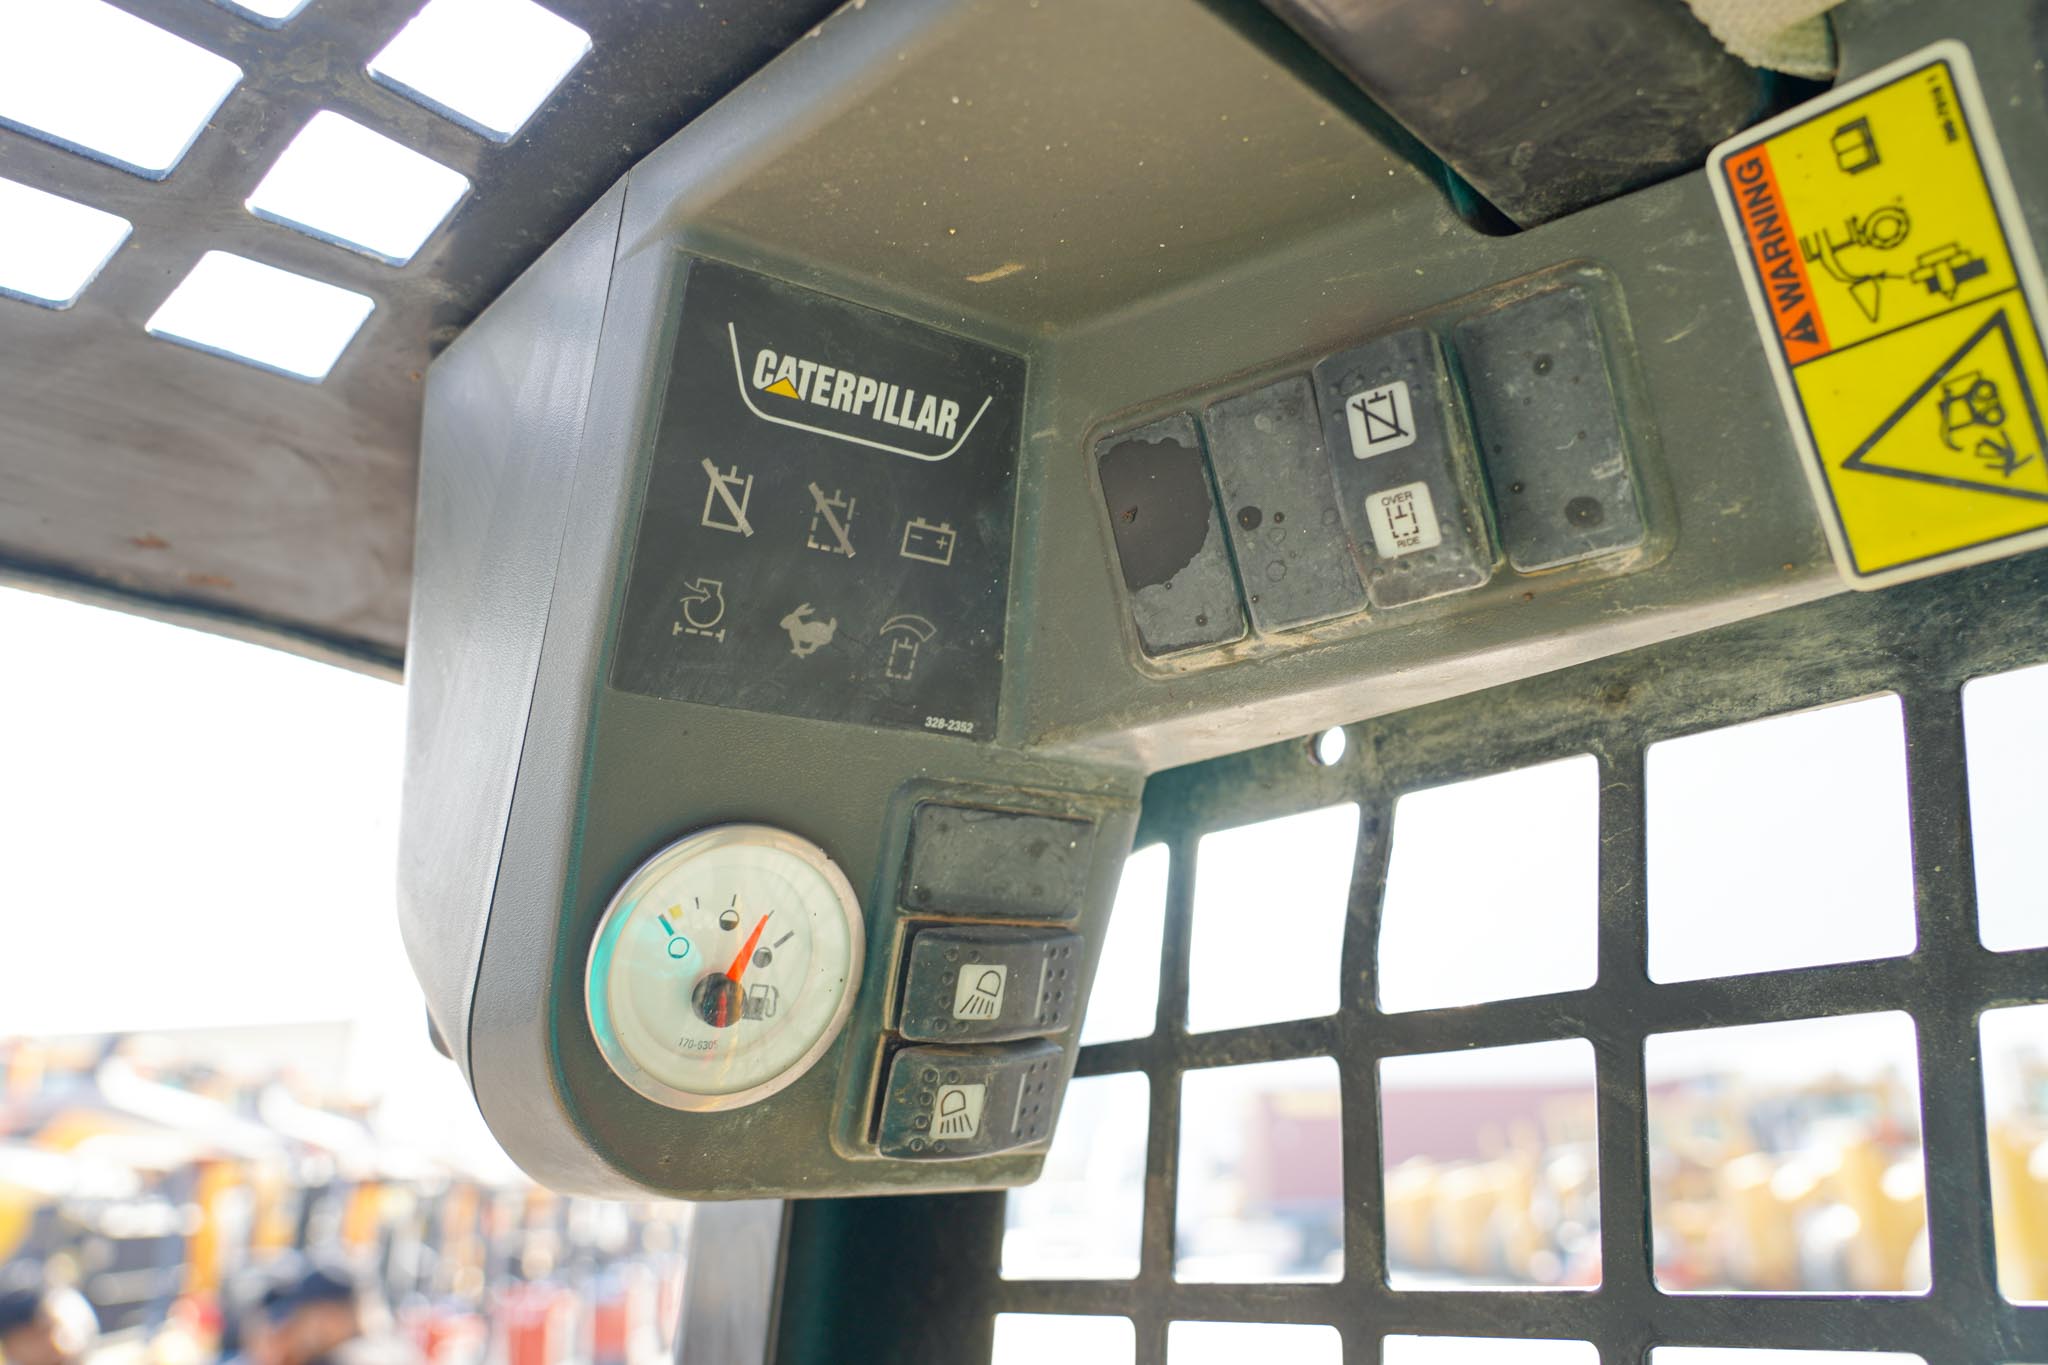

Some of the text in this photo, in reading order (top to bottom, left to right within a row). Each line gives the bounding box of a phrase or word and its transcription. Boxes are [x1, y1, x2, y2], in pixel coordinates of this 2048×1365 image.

[1736, 157, 1805, 313] WARNING
[752, 349, 961, 439] CATERPILLAR
[1381, 491, 1413, 506] OVER
[1396, 536, 1421, 548] RIDE
[924, 715, 974, 734] 328-2352
